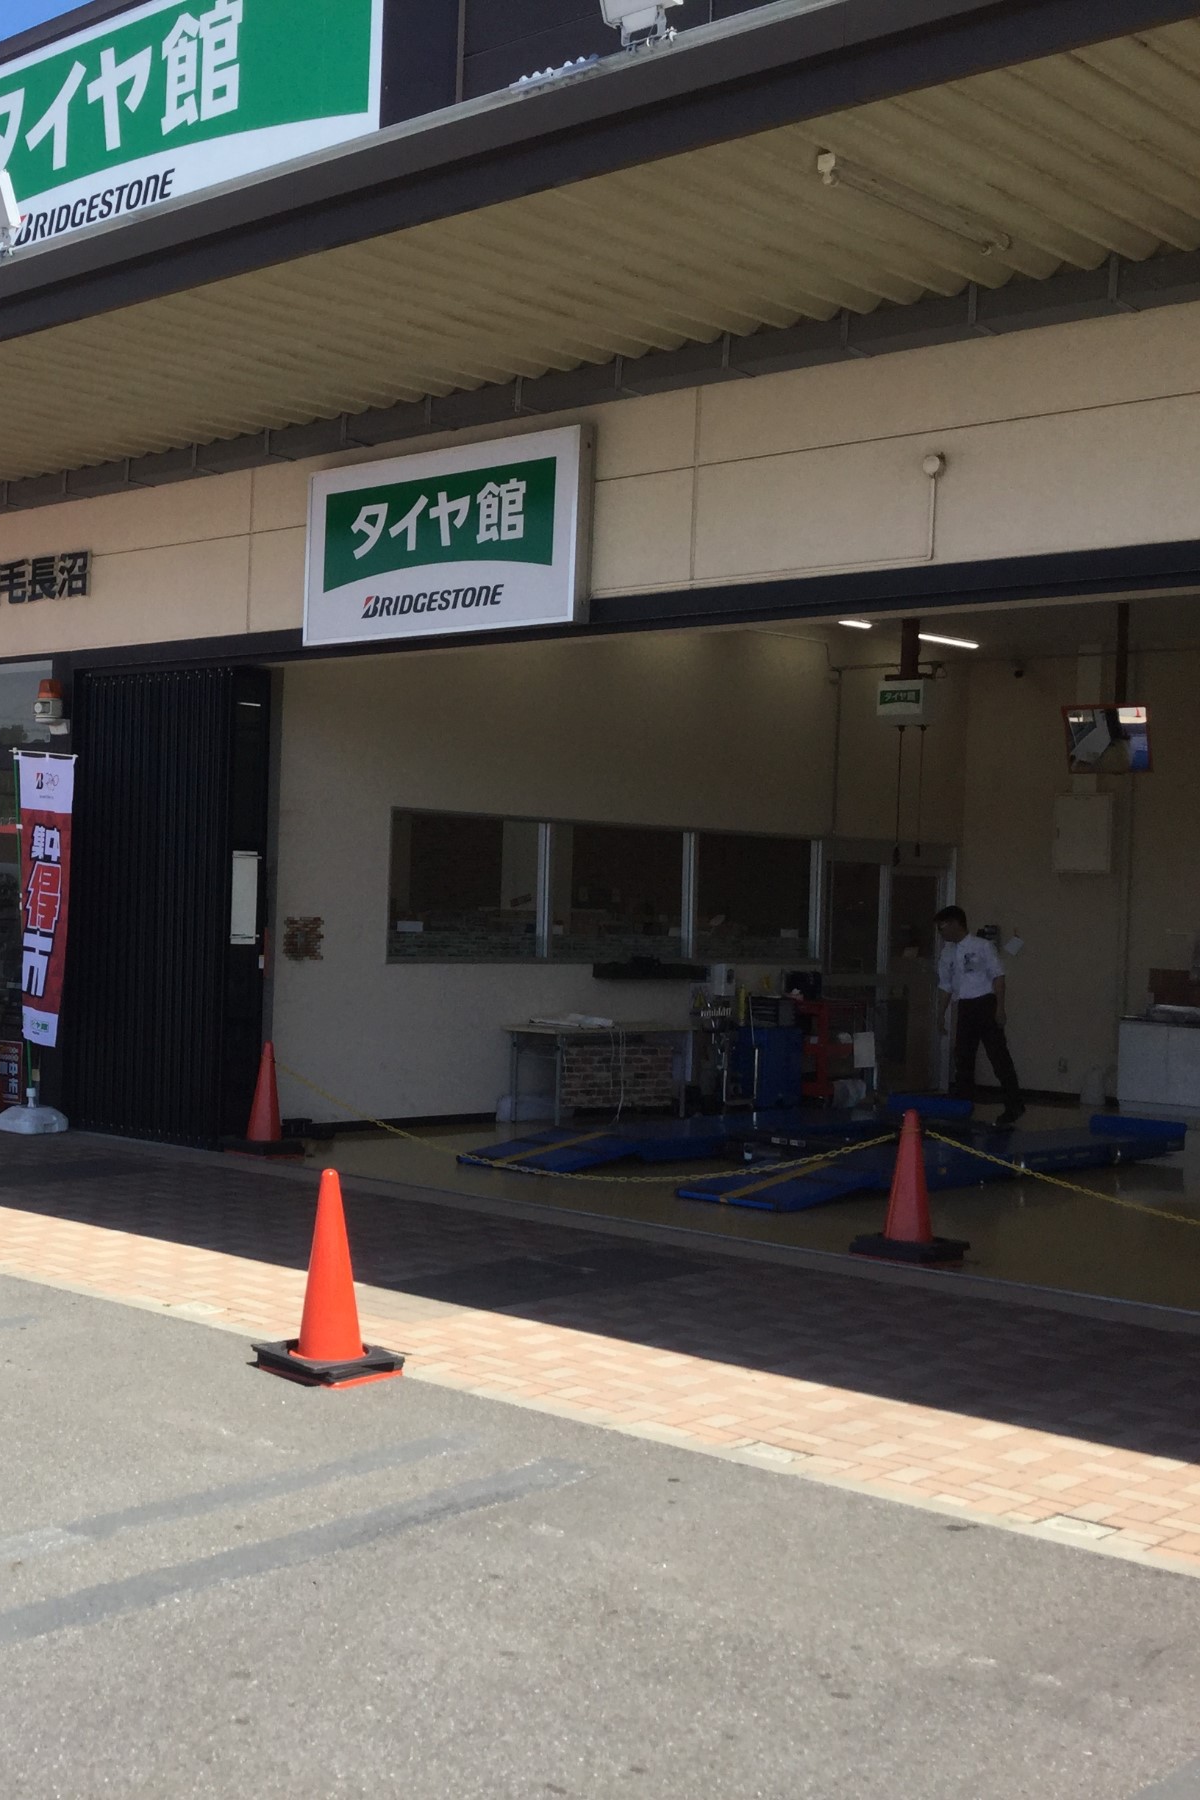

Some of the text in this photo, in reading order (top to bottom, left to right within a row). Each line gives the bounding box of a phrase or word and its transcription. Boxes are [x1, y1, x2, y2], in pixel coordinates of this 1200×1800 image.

[14, 168, 176, 247] BRIDGESTONE
[350, 478, 527, 560] タイヤ館
[361, 583, 505, 619] BRIDGESTONE
